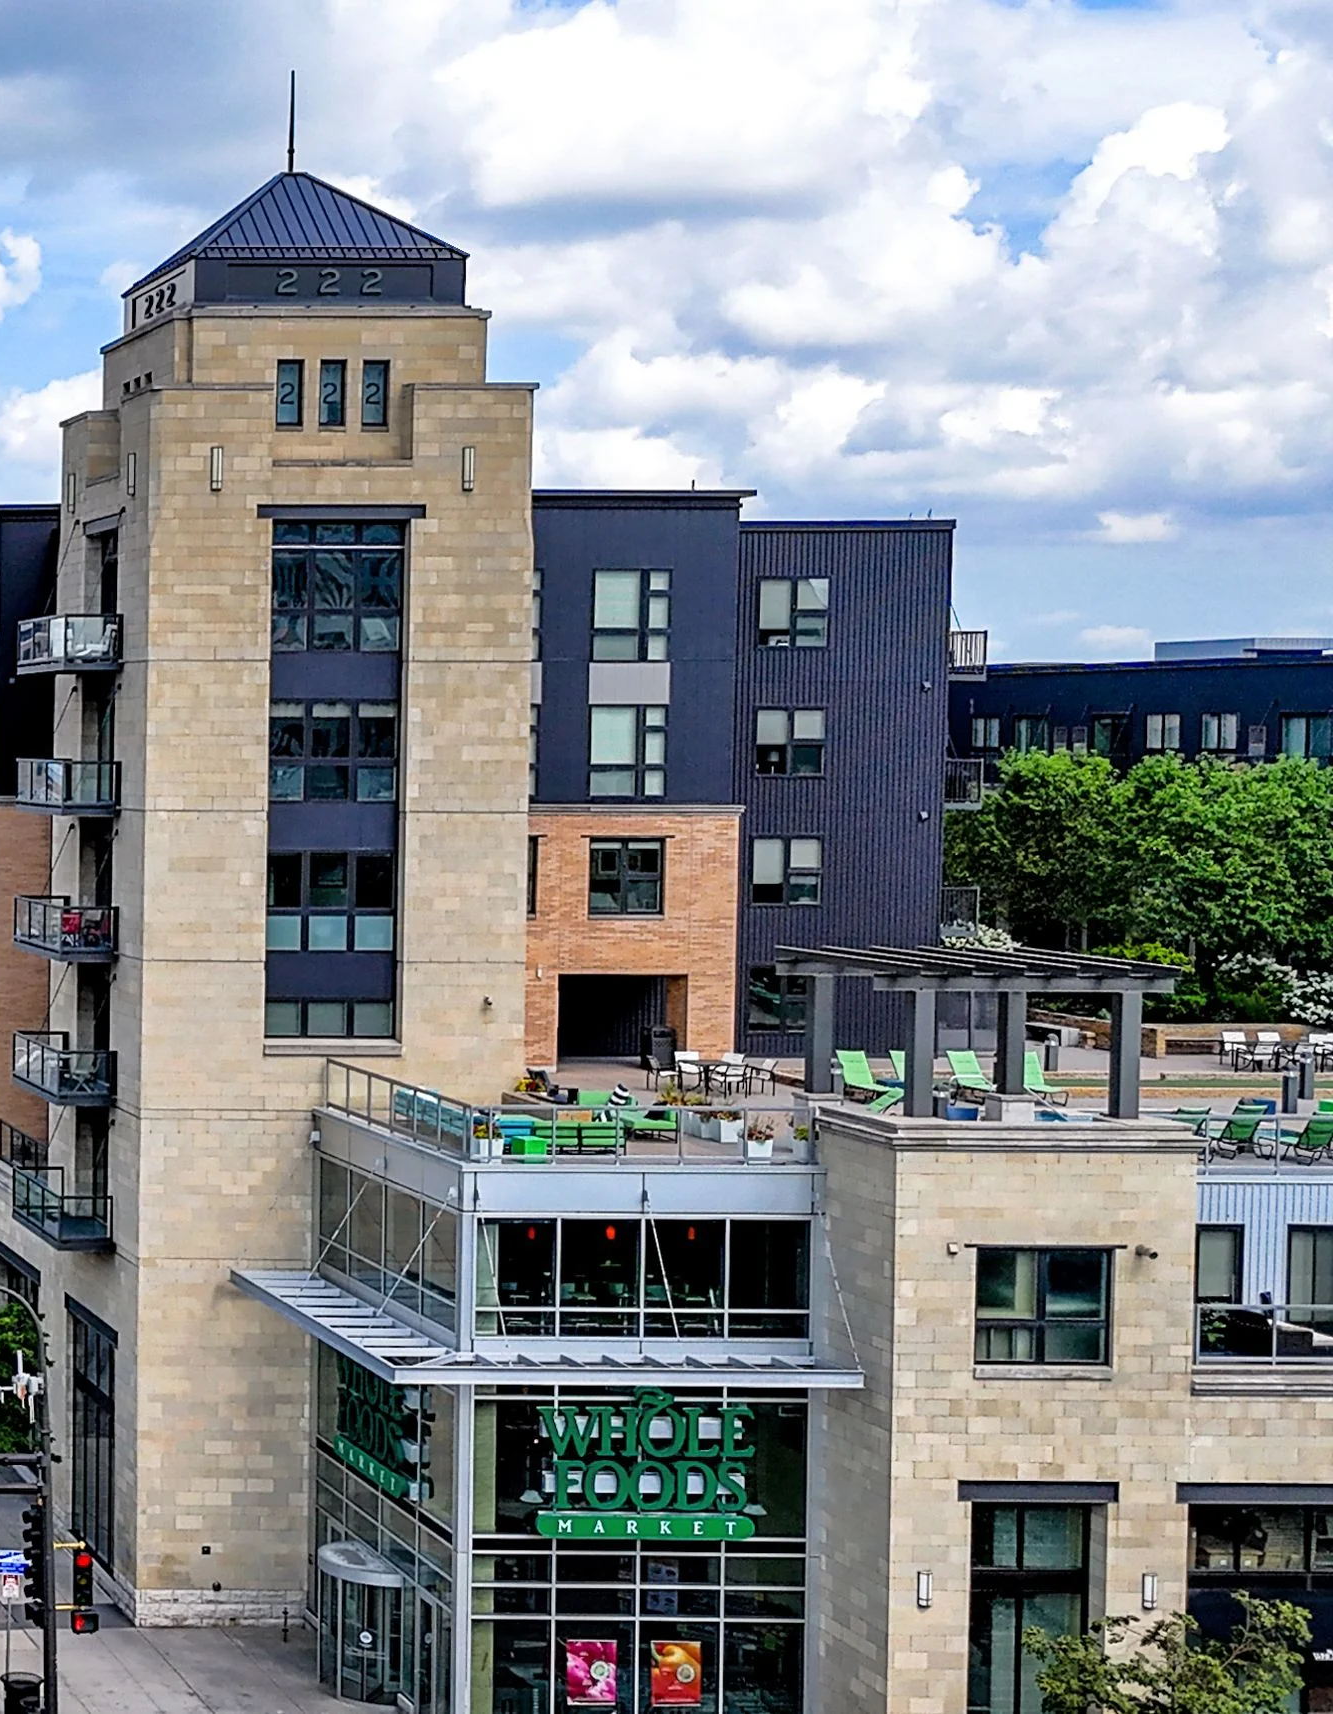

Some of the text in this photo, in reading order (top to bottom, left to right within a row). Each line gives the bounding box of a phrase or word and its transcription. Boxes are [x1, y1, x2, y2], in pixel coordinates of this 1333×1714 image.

[536, 1404, 756, 1458] WHOLE
[337, 1440, 397, 1491] MARKET
[552, 1460, 748, 1511] FOODS
[557, 1519, 737, 1535] MARKET
